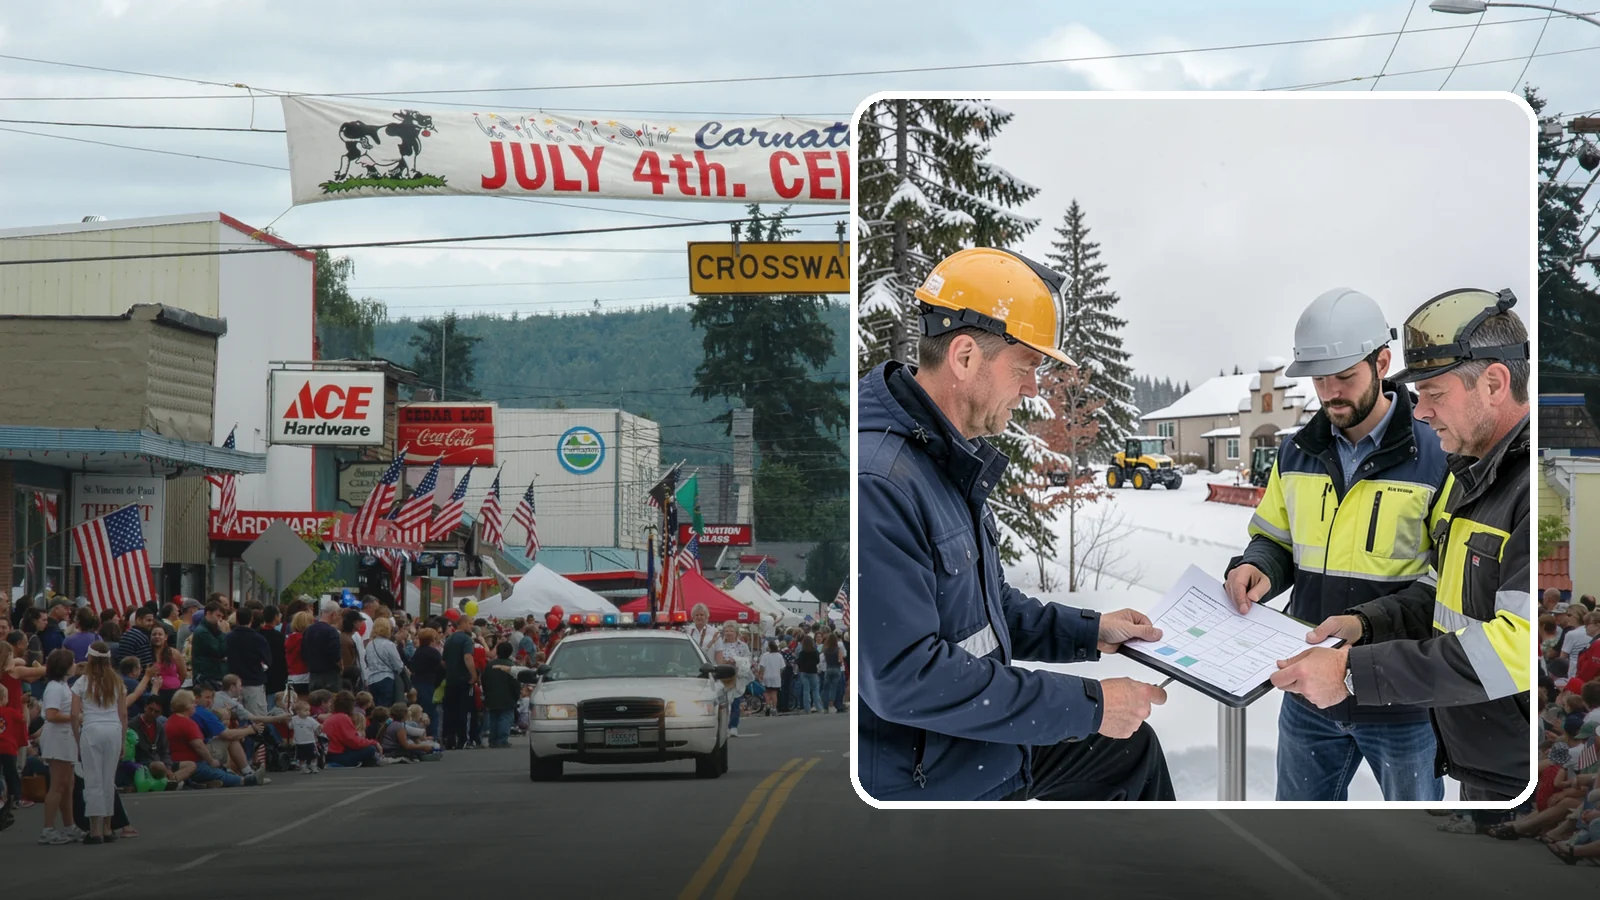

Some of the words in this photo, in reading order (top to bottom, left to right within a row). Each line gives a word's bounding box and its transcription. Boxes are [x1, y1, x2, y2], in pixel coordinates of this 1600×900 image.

[481, 141, 604, 192] JULY
[632, 150, 746, 198] 4th.
[697, 254, 850, 280] CROSSWA
[283, 380, 373, 420] ACE
[406, 409, 452, 421] CEDAR
[283, 421, 370, 436] Hardware
[353, 467, 383, 480] Simpl
[83, 486, 94, 494] St.
[96, 486, 125, 495] Vincent
[126, 486, 136, 494] de
[137, 486, 155, 495] Paul
[688, 526, 741, 535] CRNATION
[699, 535, 730, 543] GLASS
